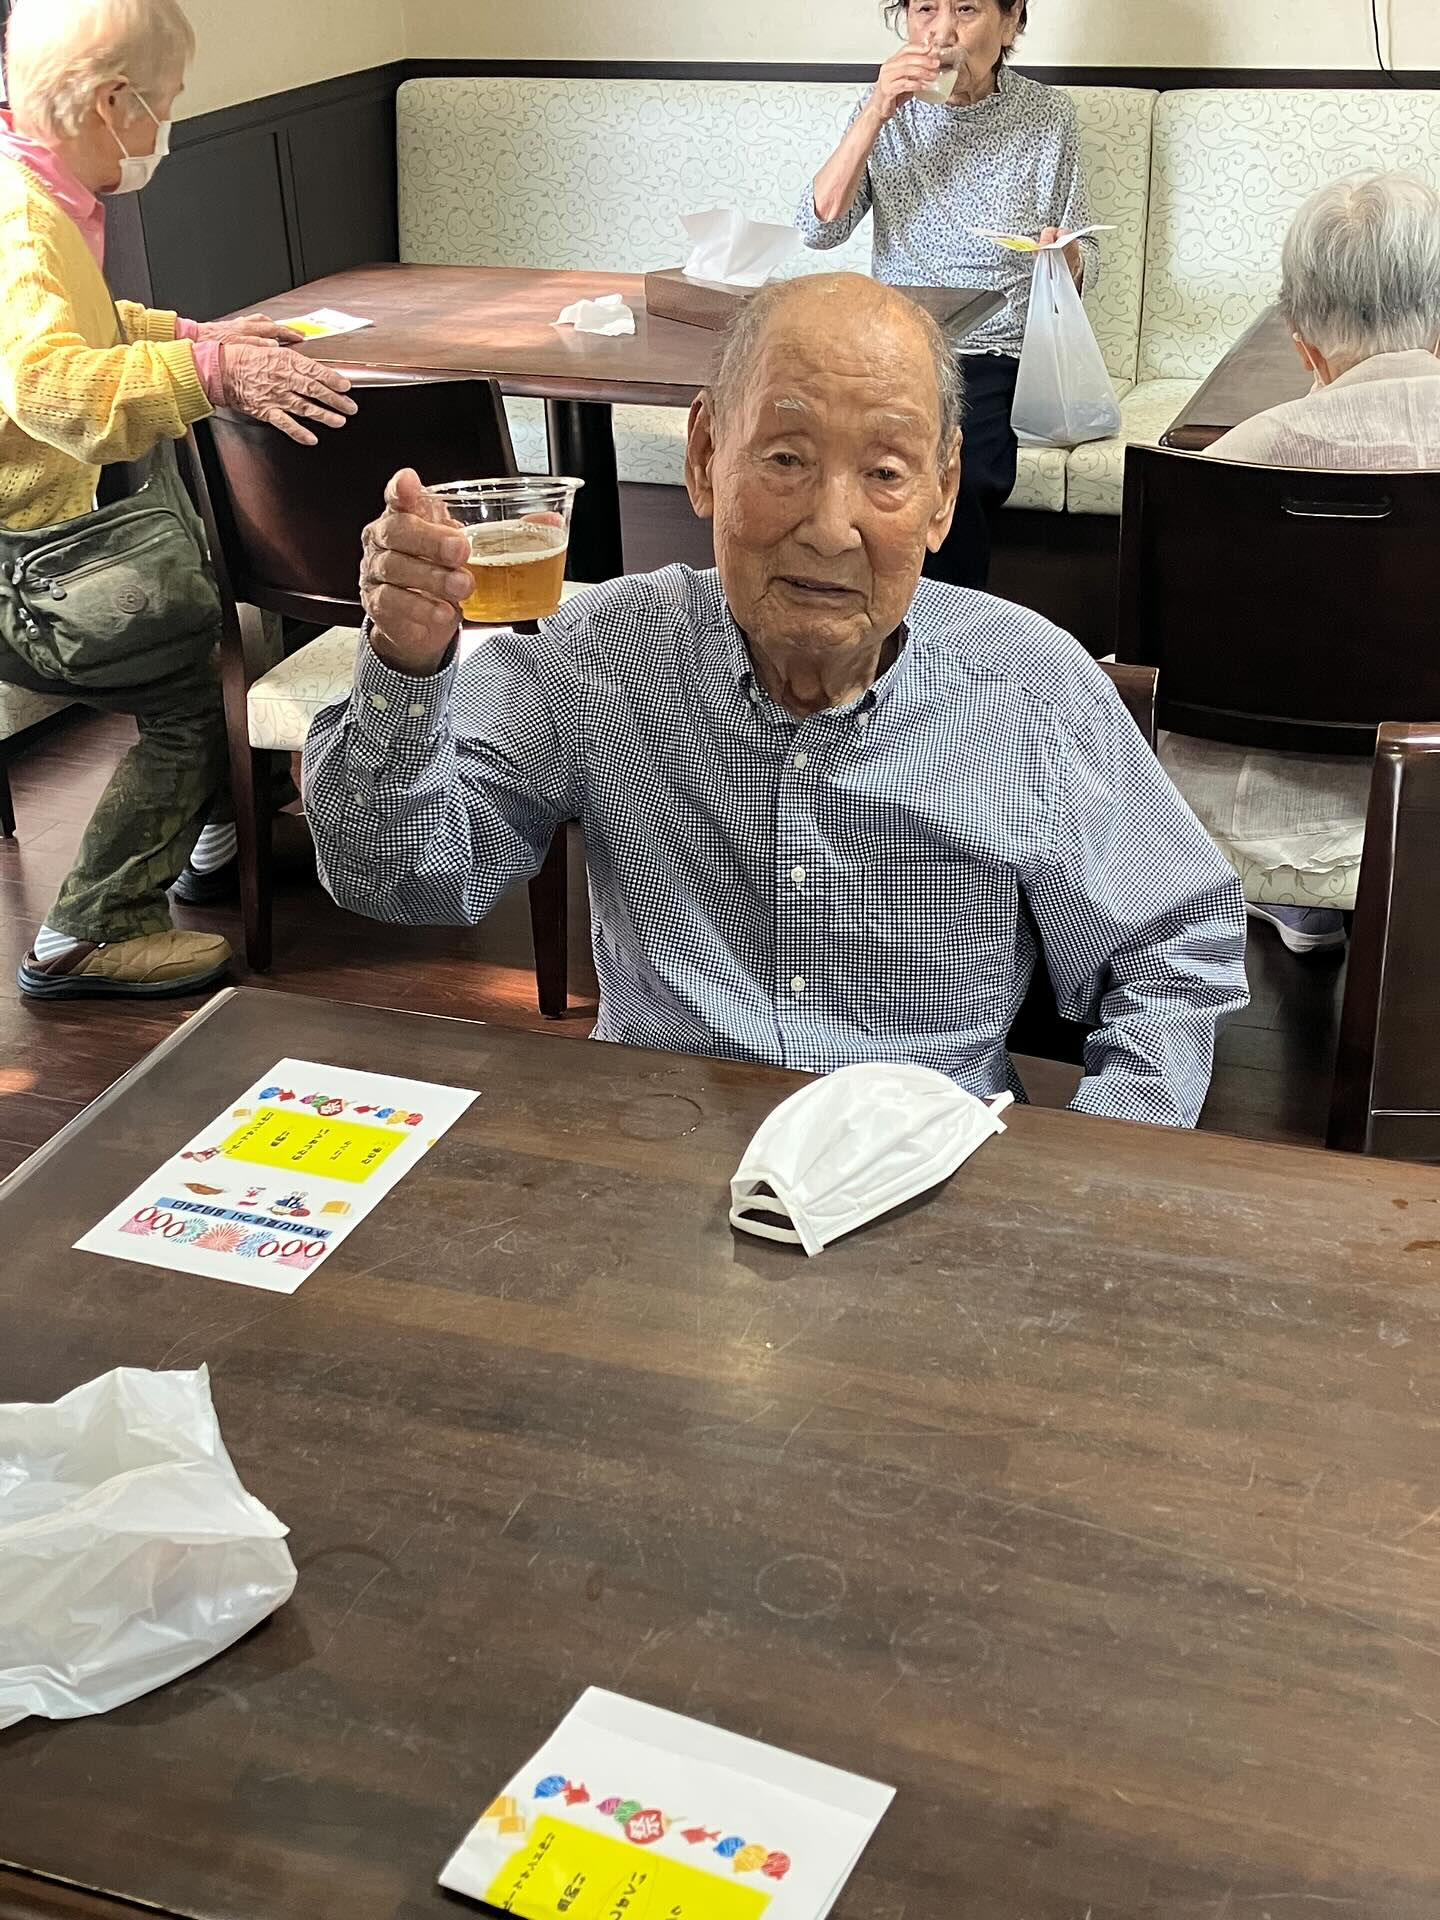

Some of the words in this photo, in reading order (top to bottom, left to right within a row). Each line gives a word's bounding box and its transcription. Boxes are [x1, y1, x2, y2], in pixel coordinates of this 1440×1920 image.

[627, 1814, 661, 1841] 祭
[557, 1872, 586, 1913] 魚釣り
